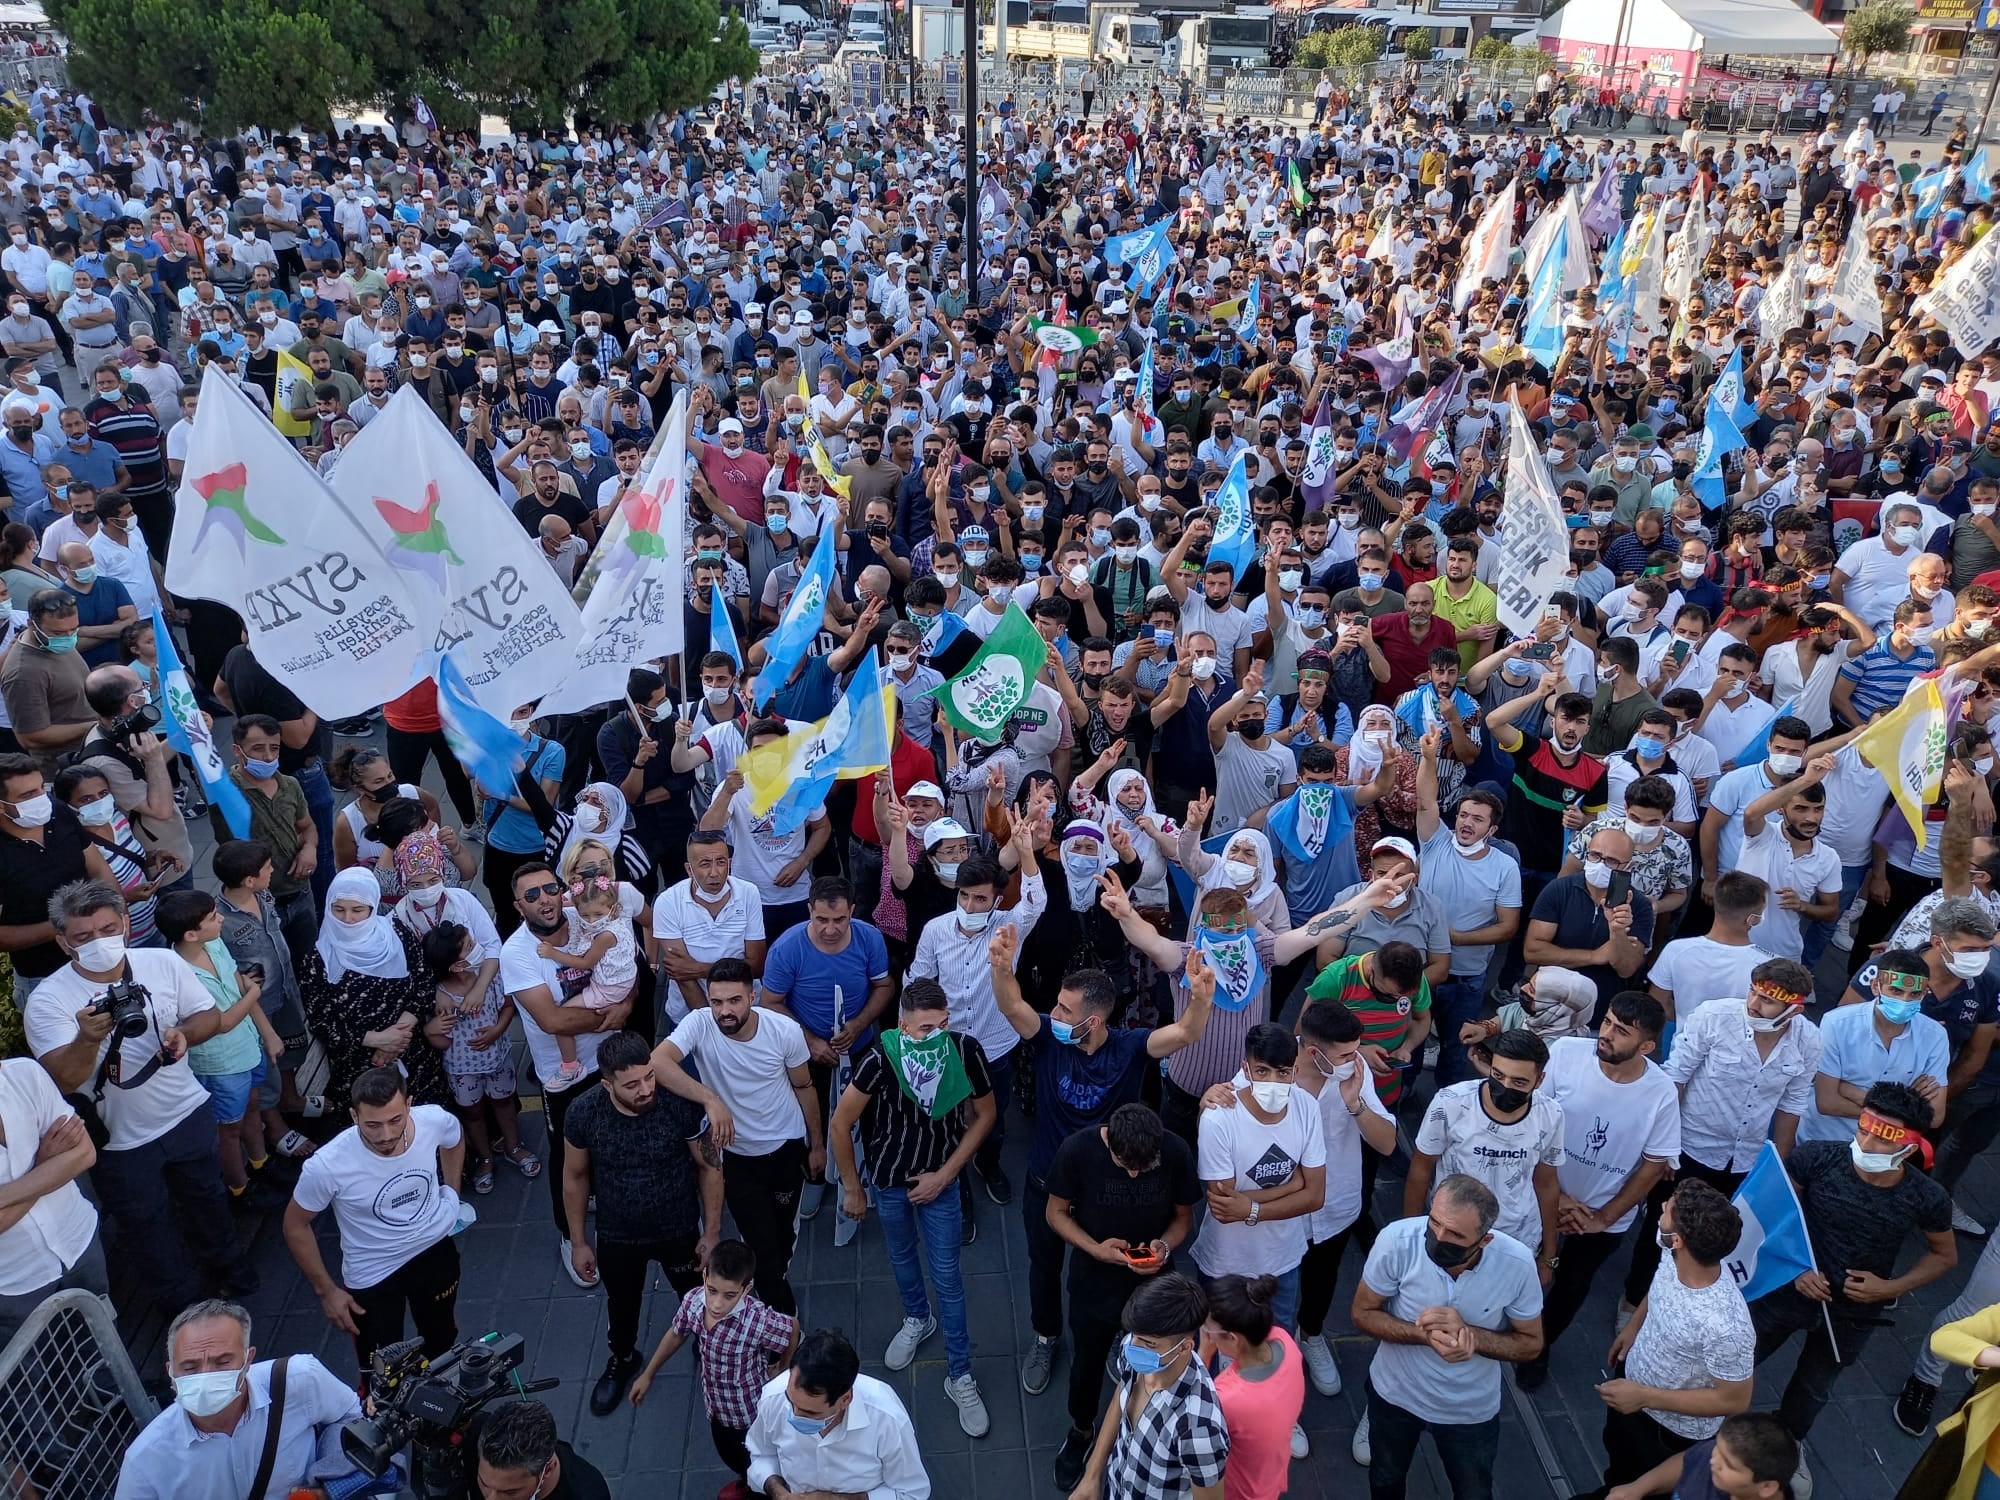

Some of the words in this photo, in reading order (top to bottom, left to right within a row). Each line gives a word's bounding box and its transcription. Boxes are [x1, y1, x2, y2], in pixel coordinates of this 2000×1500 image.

[1767, 983, 1799, 1003] HDP
[1870, 1122, 1906, 1143] HDP
[1473, 1145, 1528, 1160] staunch
[1255, 1158, 1292, 1172] secret
[1254, 1167, 1292, 1182] places
